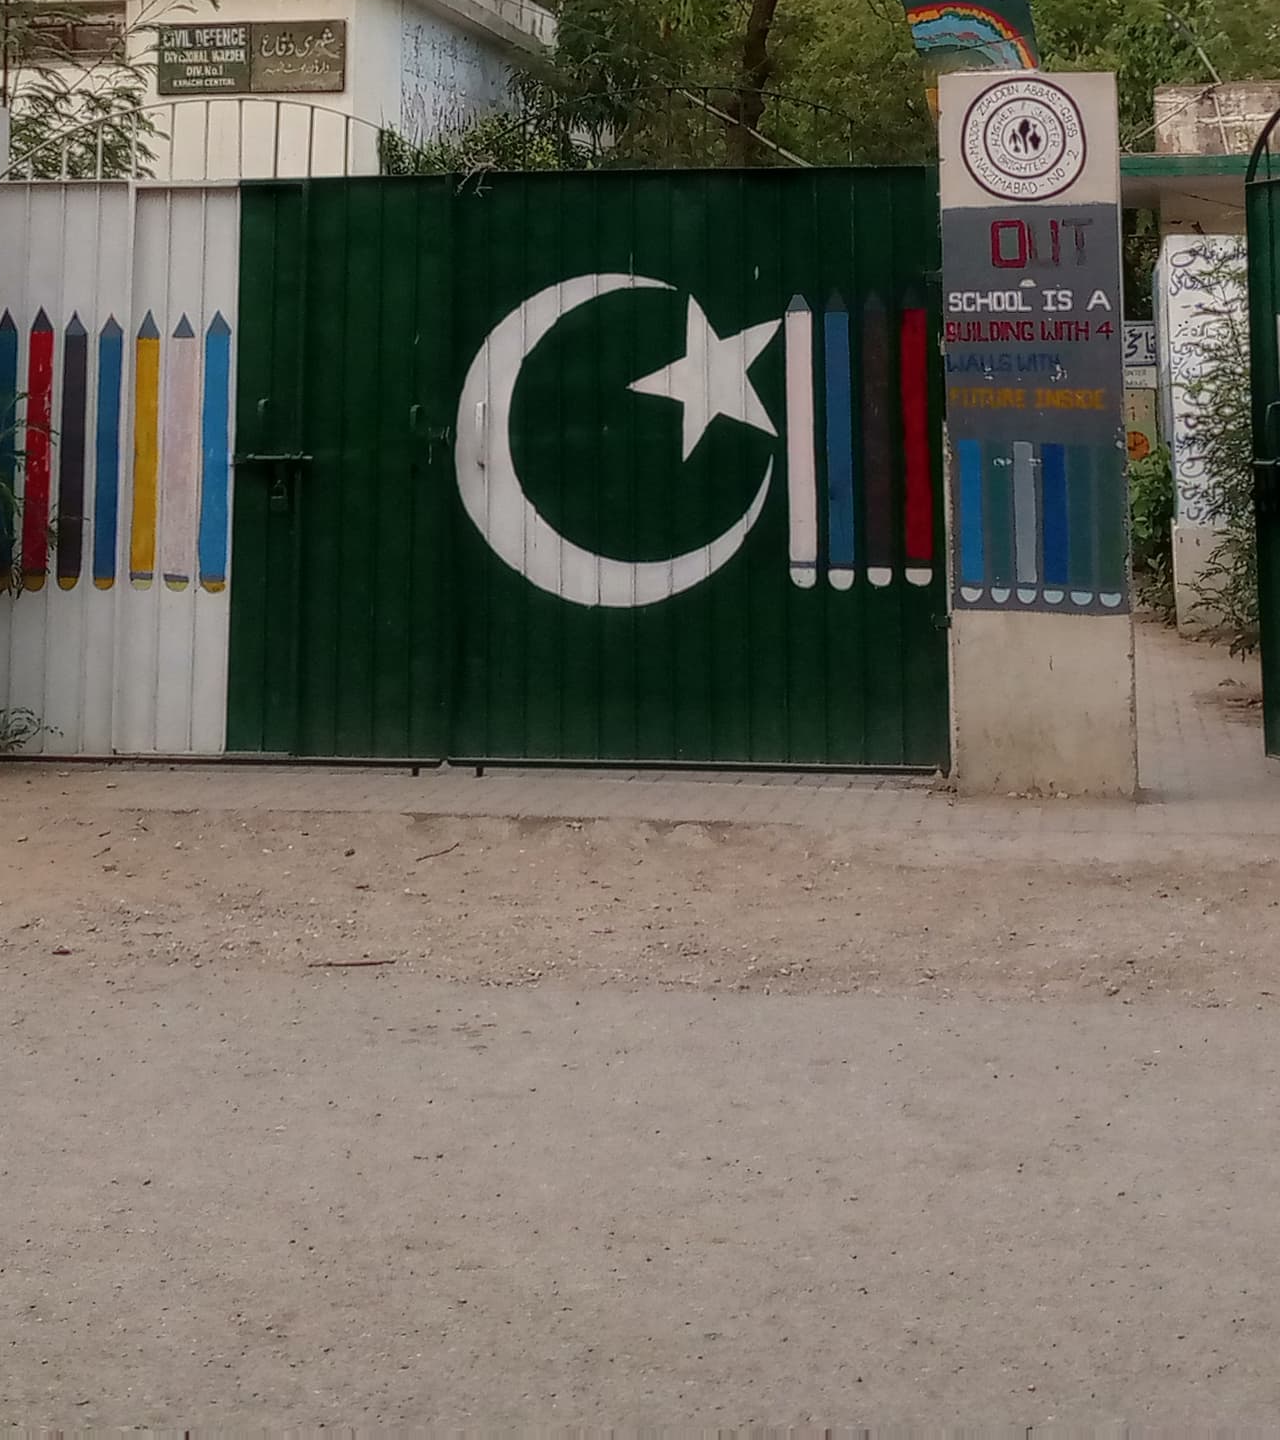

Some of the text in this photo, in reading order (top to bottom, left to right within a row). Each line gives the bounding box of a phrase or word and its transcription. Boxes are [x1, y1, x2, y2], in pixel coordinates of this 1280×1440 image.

[163, 28, 246, 48] CIVIL DEFENCE
[991, 218, 1094, 269] OUT
[948, 289, 1112, 312] SCHOOL IS A
[945, 320, 1114, 343] BUILDING WITH 4
